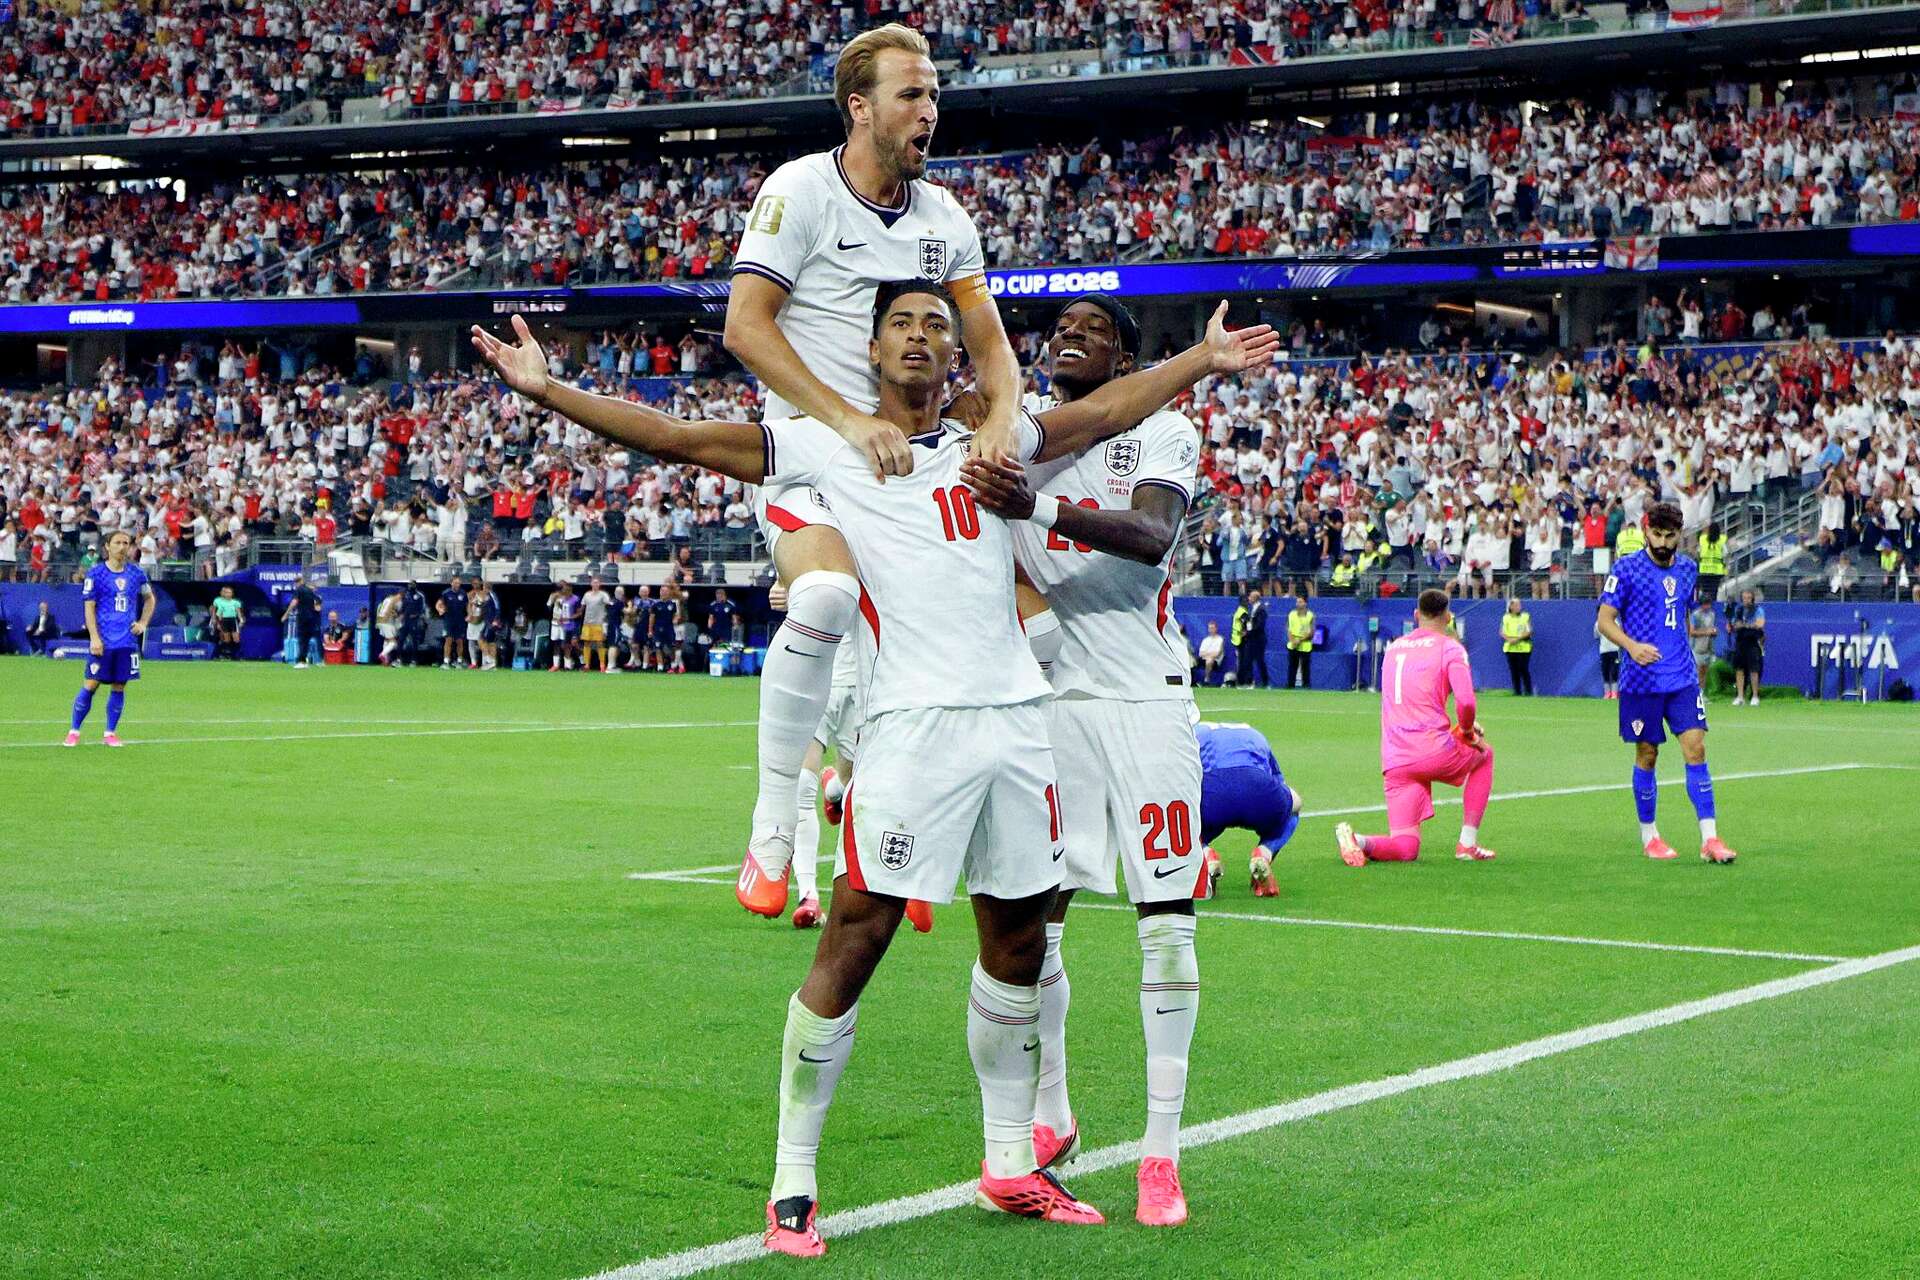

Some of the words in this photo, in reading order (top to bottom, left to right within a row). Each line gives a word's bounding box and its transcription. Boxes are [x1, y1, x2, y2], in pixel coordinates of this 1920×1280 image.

[1007, 275, 1047, 294] CUP
[1049, 271, 1120, 293] 2026
[932, 484, 981, 542] 10
[115, 596, 127, 612] 10
[1664, 608, 1677, 631] 4
[1810, 634, 1899, 670] FIFA
[1394, 653, 1407, 705] 1
[1044, 780, 1064, 842] 1
[1139, 799, 1193, 861] 20
